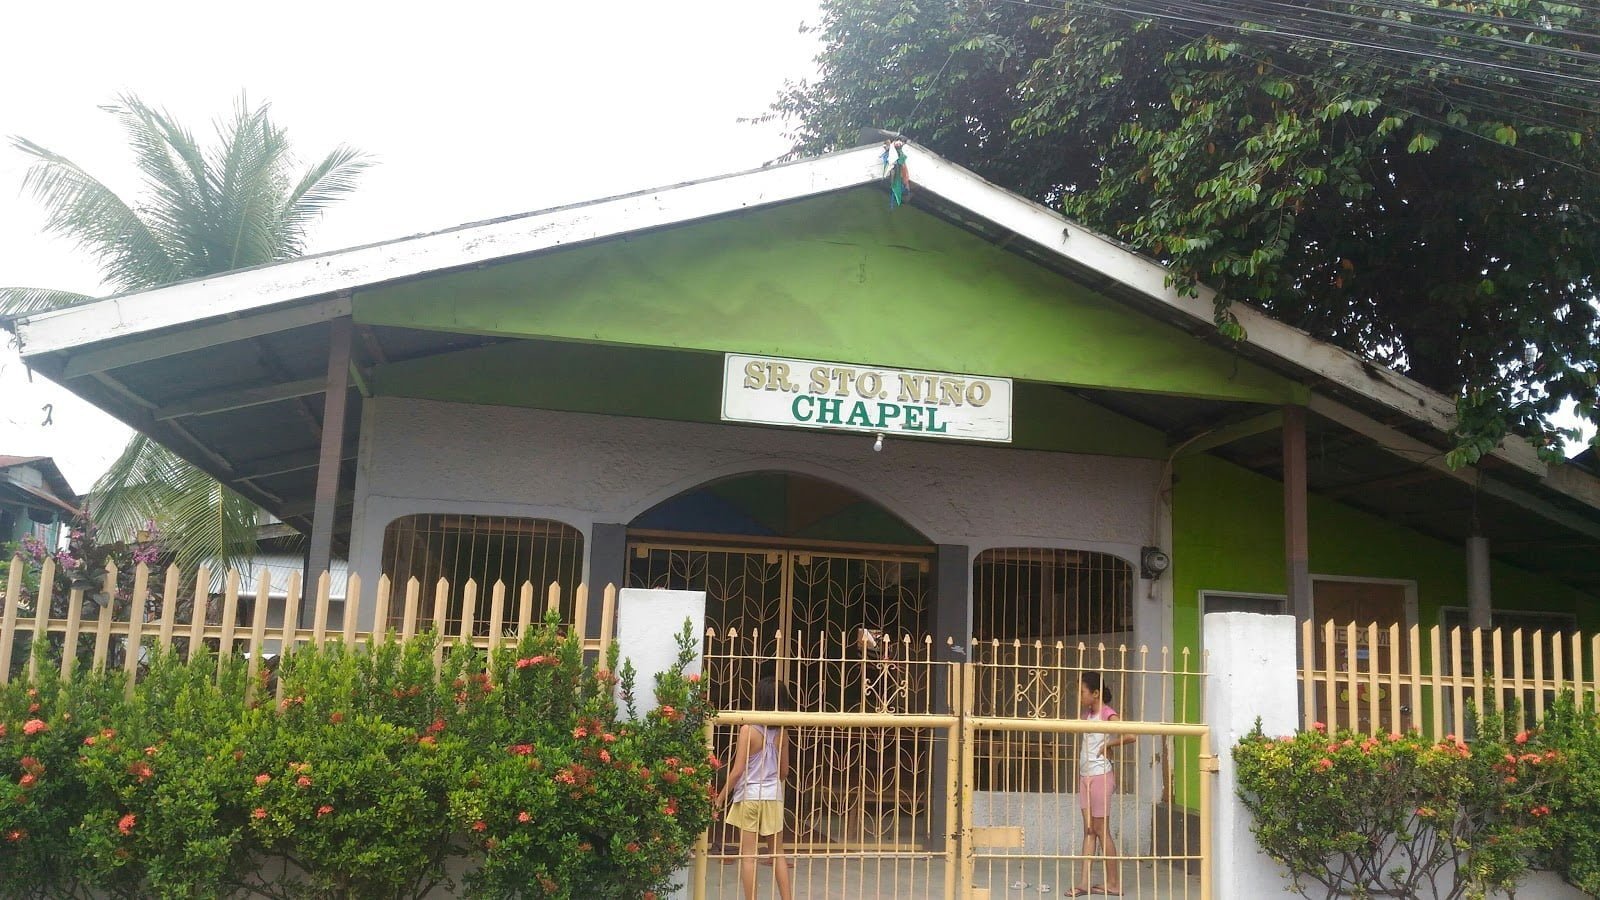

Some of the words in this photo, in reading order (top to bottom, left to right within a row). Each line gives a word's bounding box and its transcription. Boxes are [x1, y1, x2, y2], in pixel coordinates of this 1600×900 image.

[743, 360, 800, 394] SR.
[808, 366, 888, 400] STO.
[898, 373, 992, 407] NIÑO
[791, 394, 947, 433] CHAPEL
[1322, 627, 1396, 645] ECOM
